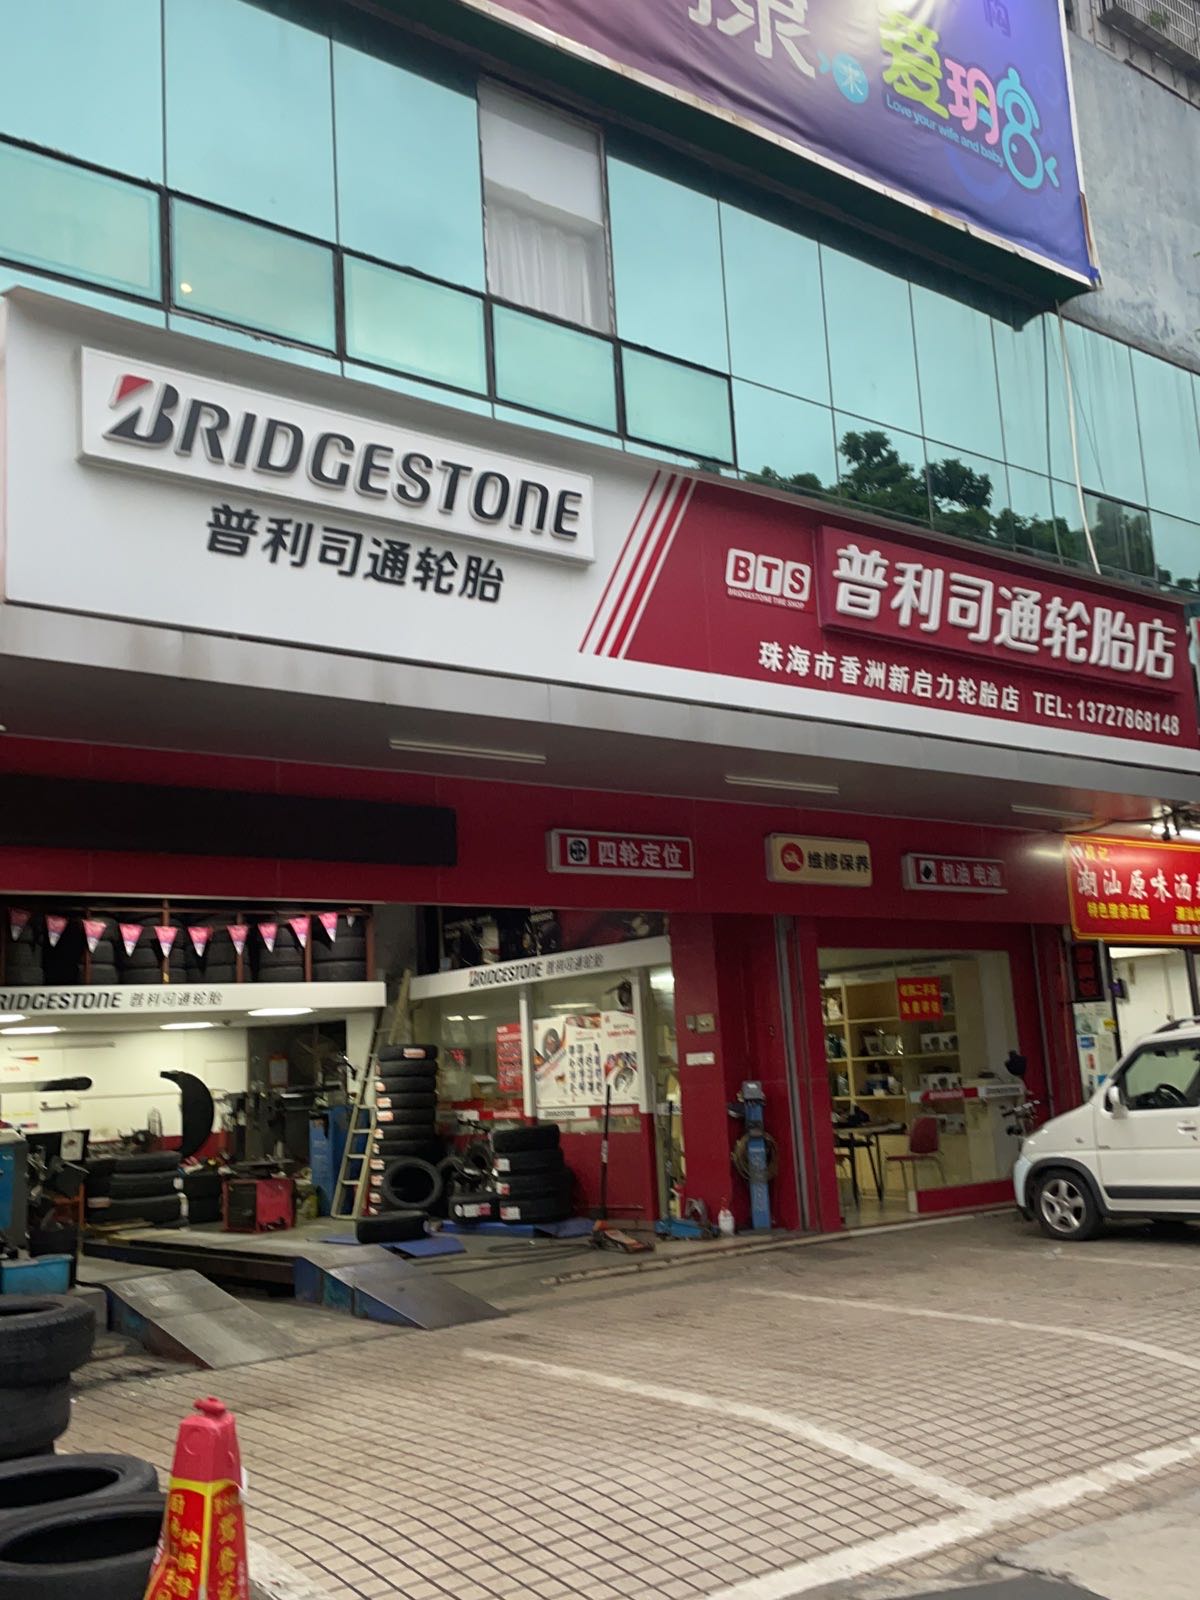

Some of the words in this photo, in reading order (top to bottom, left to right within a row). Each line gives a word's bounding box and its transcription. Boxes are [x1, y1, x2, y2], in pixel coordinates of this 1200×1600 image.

[886, 93, 912, 118] Love
[913, 112, 937, 130] your
[960, 136, 980, 153] and
[979, 144, 1004, 168] baby
[102, 374, 583, 540] BRIDGESTONE
[206, 503, 505, 604] 普利司通轮胎
[725, 548, 812, 602] BTS
[831, 543, 1176, 680] 普利司通轮胎店
[758, 640, 1020, 713] 珠海市香洲新启力轮胎店
[1032, 690, 1073, 720] TEL:
[1077, 699, 1180, 737] 13727868148
[597, 839, 684, 869] 四轮定位
